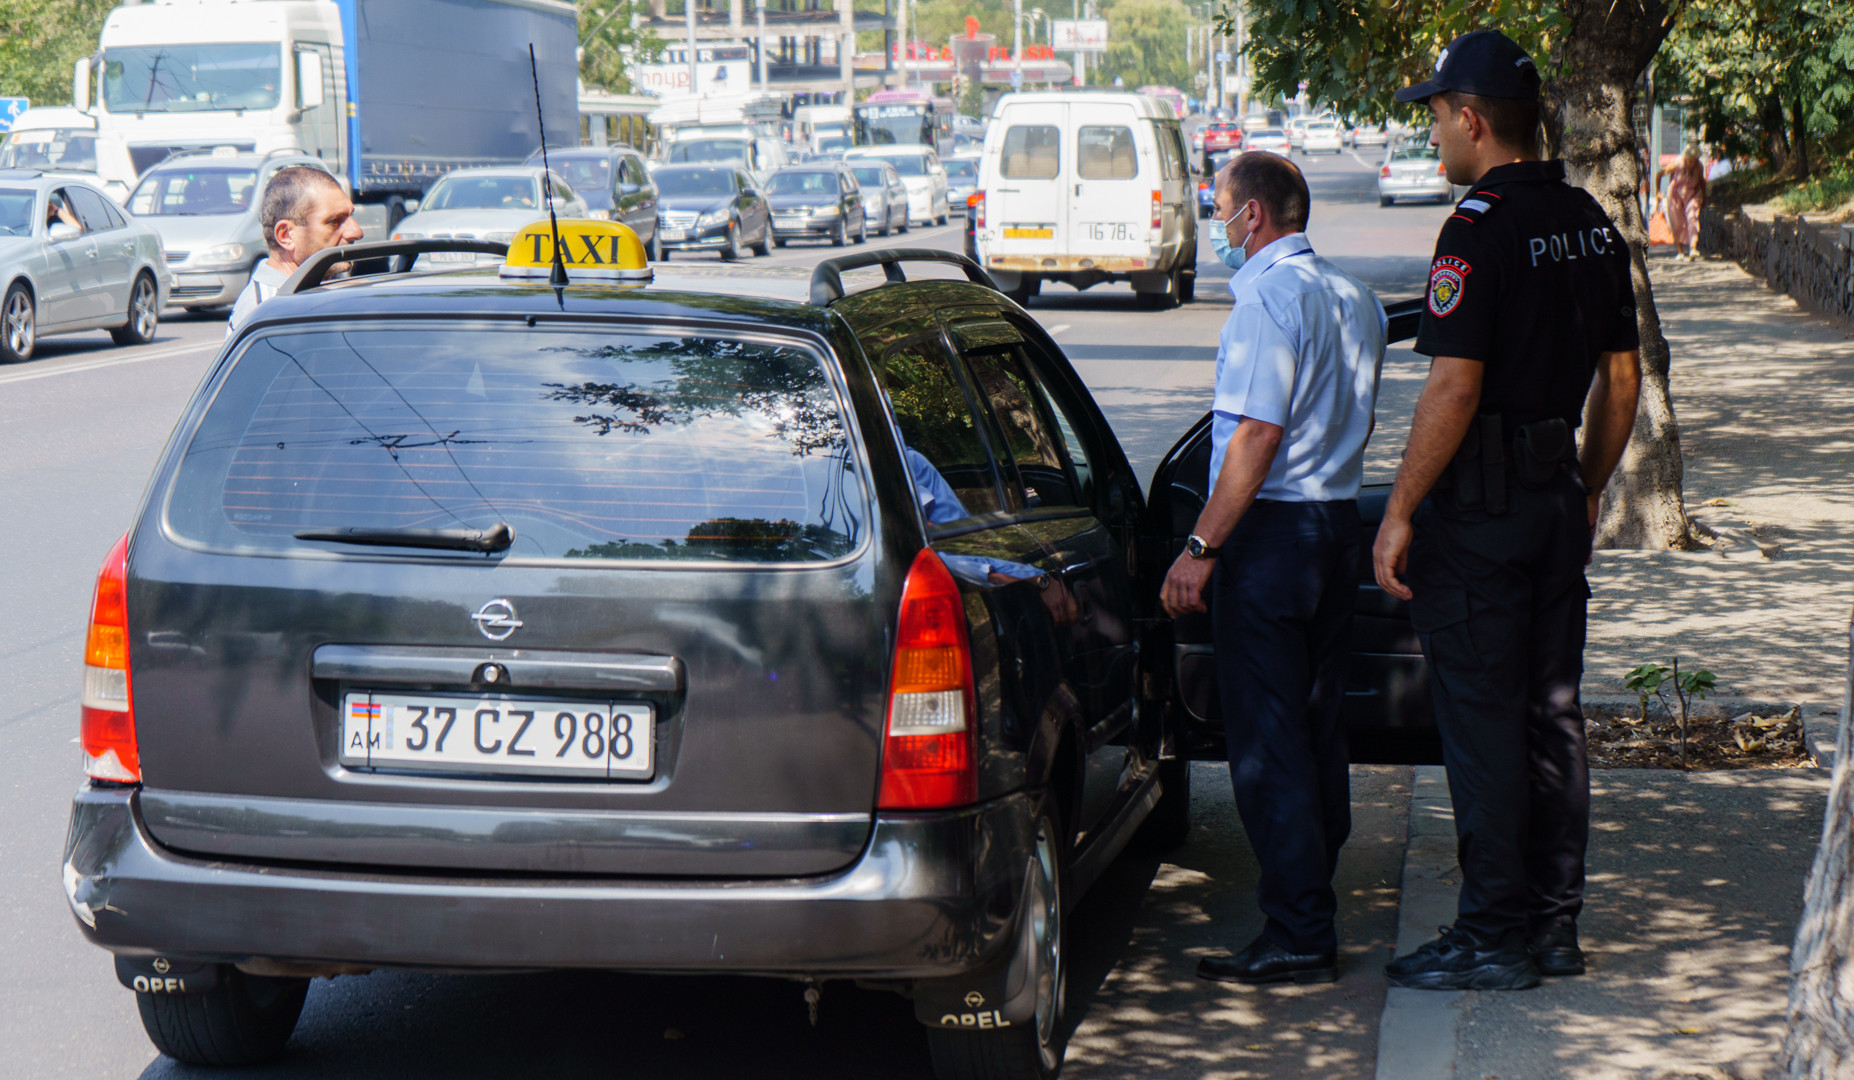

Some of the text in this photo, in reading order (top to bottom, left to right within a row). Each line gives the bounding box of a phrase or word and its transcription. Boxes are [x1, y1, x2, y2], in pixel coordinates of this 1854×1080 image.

[525, 233, 622, 264] TAXI
[1529, 227, 1614, 267] POLICE
[1433, 258, 1467, 271] POLICE
[351, 731, 381, 749] AM
[406, 705, 634, 760] 37 CZ 988
[941, 1010, 1011, 1029] OPEL
